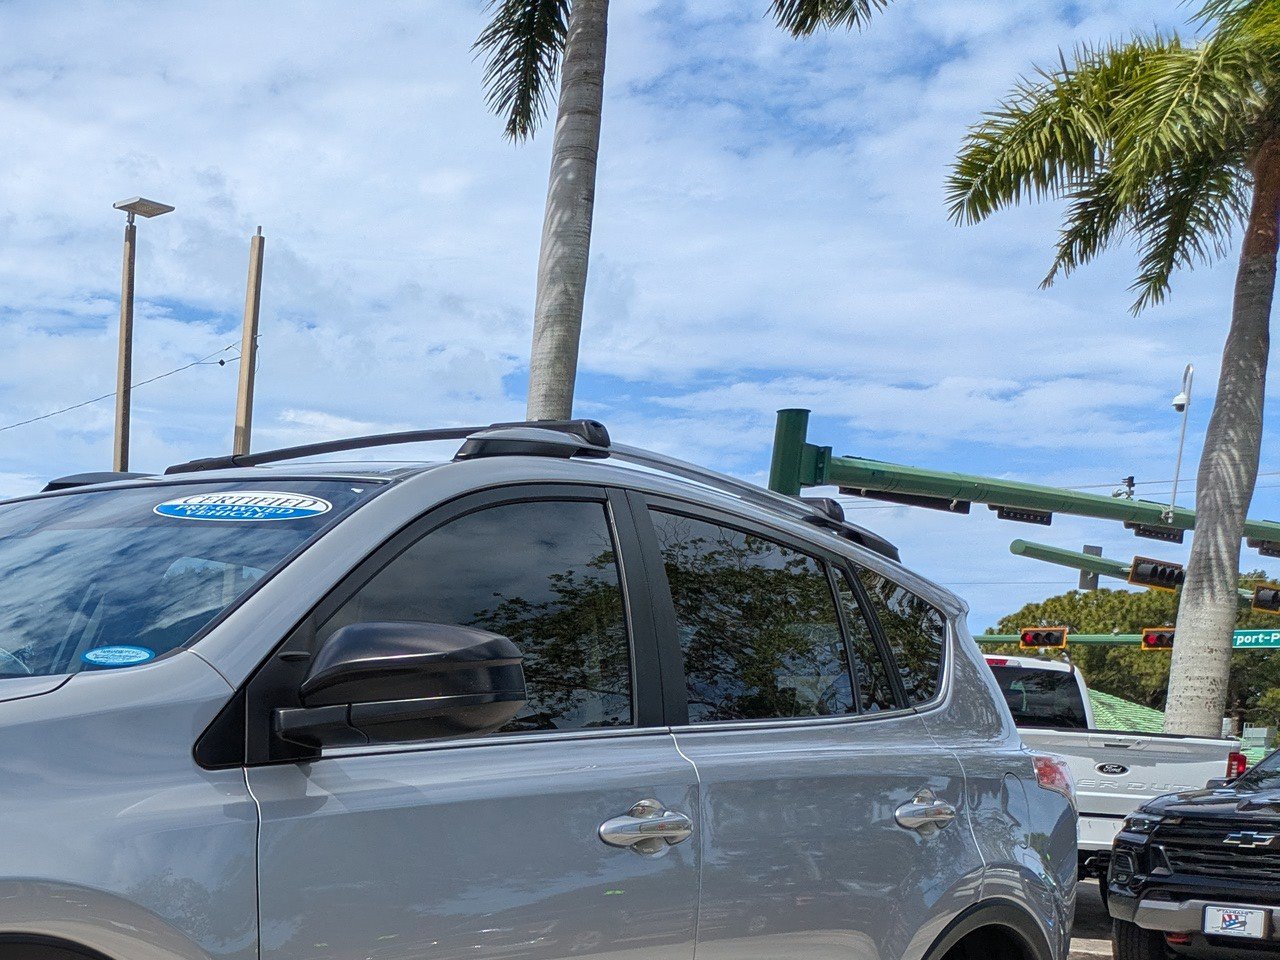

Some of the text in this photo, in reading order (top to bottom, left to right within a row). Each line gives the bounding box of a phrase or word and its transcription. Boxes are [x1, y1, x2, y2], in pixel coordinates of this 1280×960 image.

[184, 495, 319, 509] CERTIFIED
[184, 509, 270, 518] VEHICLE
[1103, 764, 1122, 774] Ford
